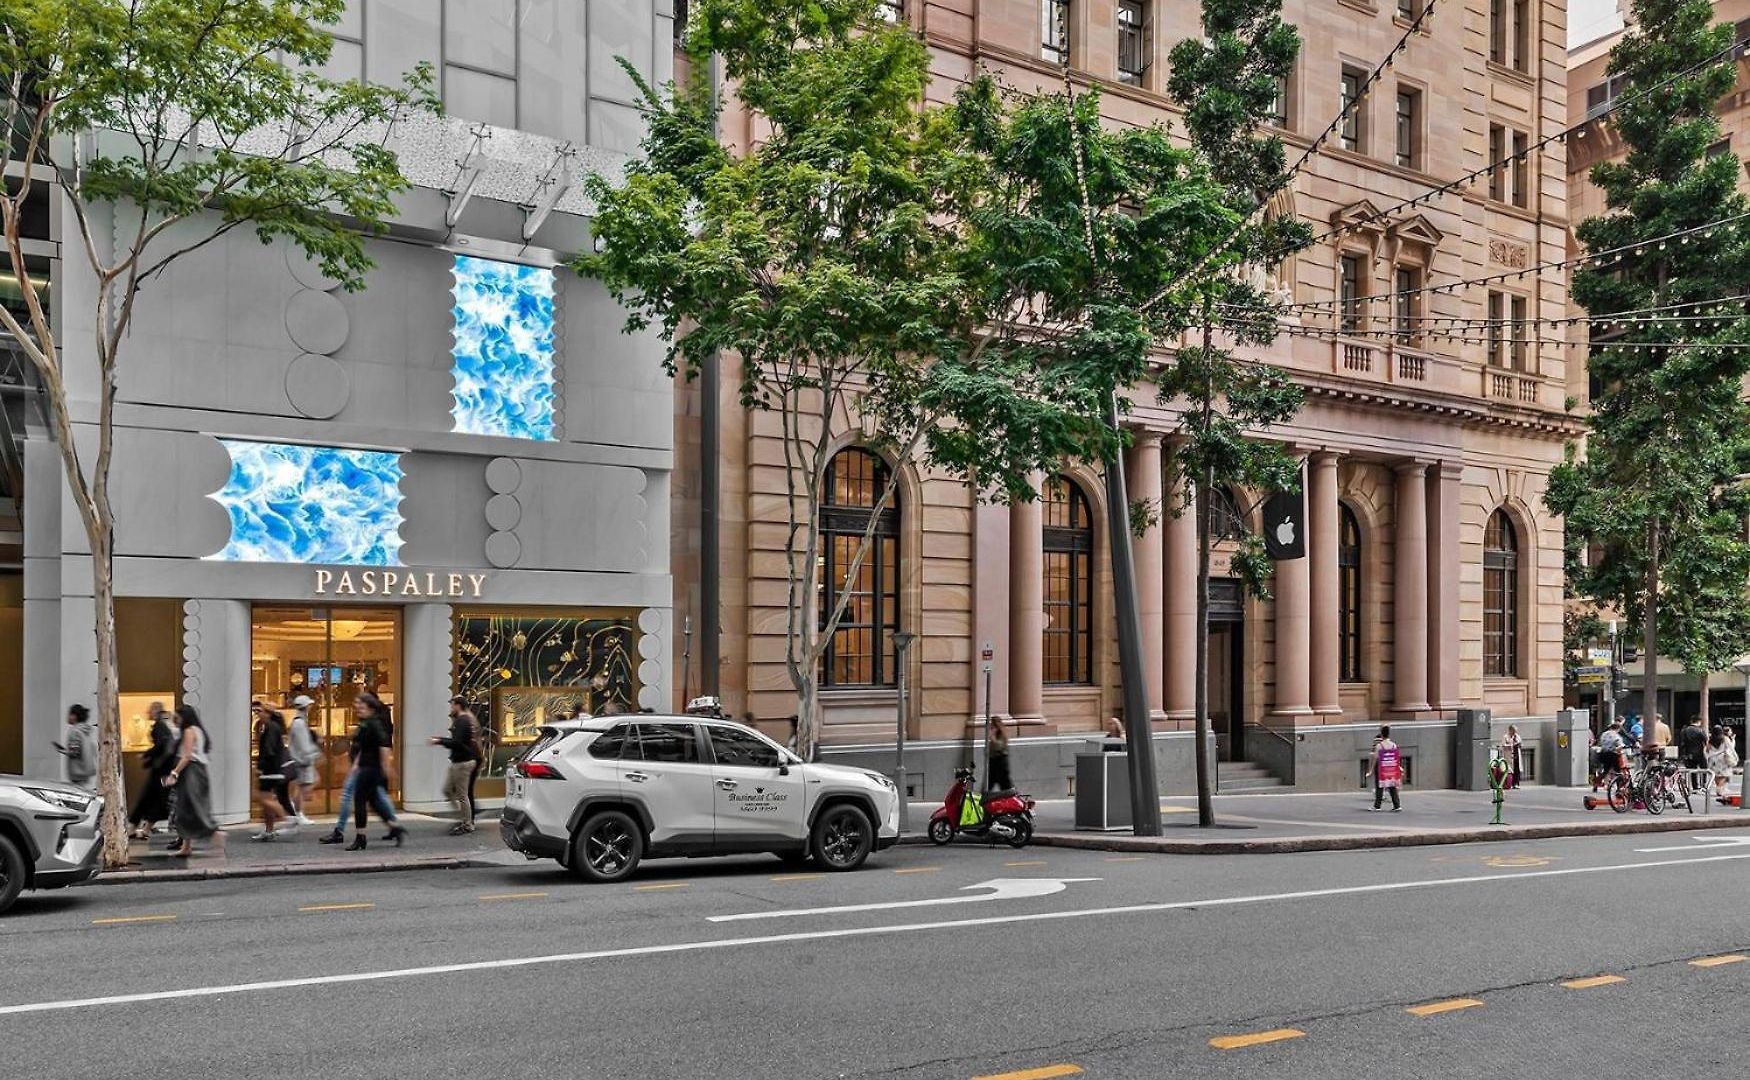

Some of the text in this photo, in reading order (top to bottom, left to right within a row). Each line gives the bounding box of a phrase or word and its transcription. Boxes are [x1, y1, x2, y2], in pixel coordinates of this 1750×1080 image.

[315, 569, 486, 597] PASPALEY
[728, 791, 788, 802] Business Class
